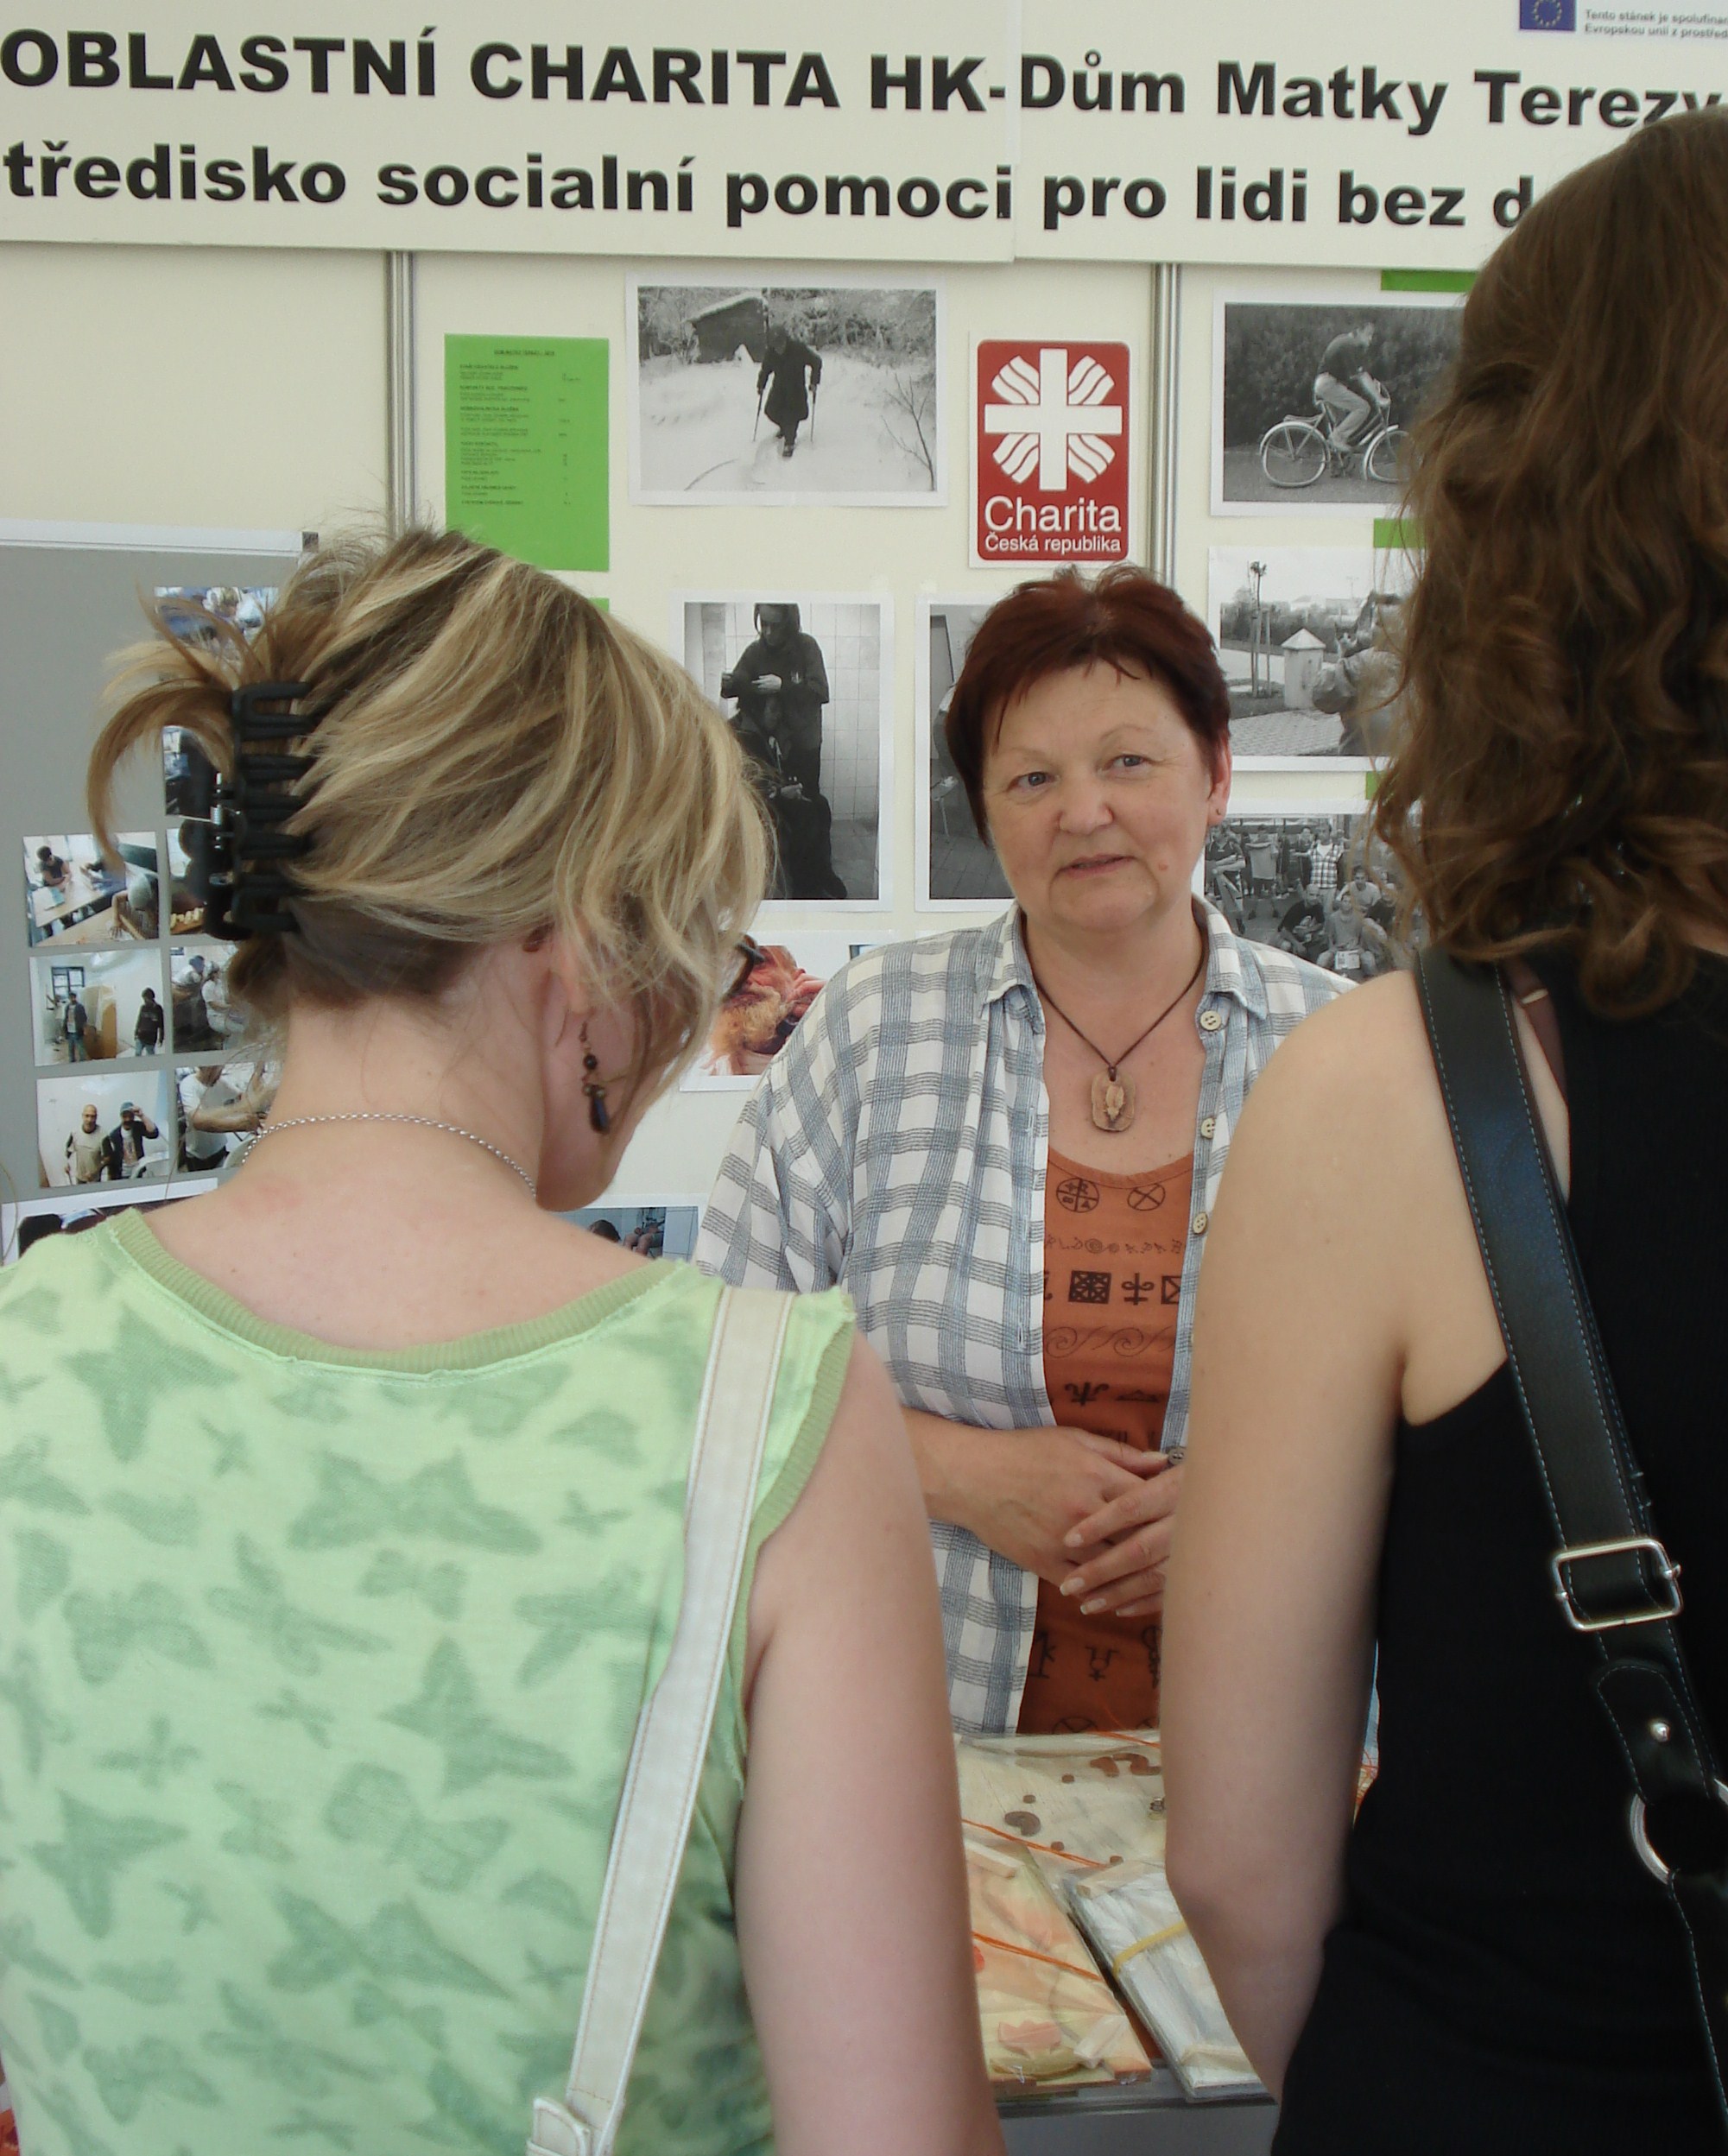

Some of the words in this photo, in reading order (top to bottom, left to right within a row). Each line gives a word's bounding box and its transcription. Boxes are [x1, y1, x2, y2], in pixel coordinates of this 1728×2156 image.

[1585, 23, 1644, 36] Evropskou
[1586, 9, 1616, 22] Tento
[1618, 9, 1654, 22] stánek
[1658, 11, 1668, 24] je
[0, 27, 436, 97] OBLASTNÍ
[470, 42, 841, 108] CHARITA
[1217, 60, 1448, 136] Matky
[377, 153, 695, 212] socialní
[726, 165, 1012, 228] pomoci
[1043, 176, 1167, 231] pro
[1196, 166, 1307, 222] lidi
[1339, 170, 1466, 226] bez
[984, 494, 1122, 533] Charita
[985, 531, 1039, 552] Česká
[1044, 534, 1122, 555] republika
